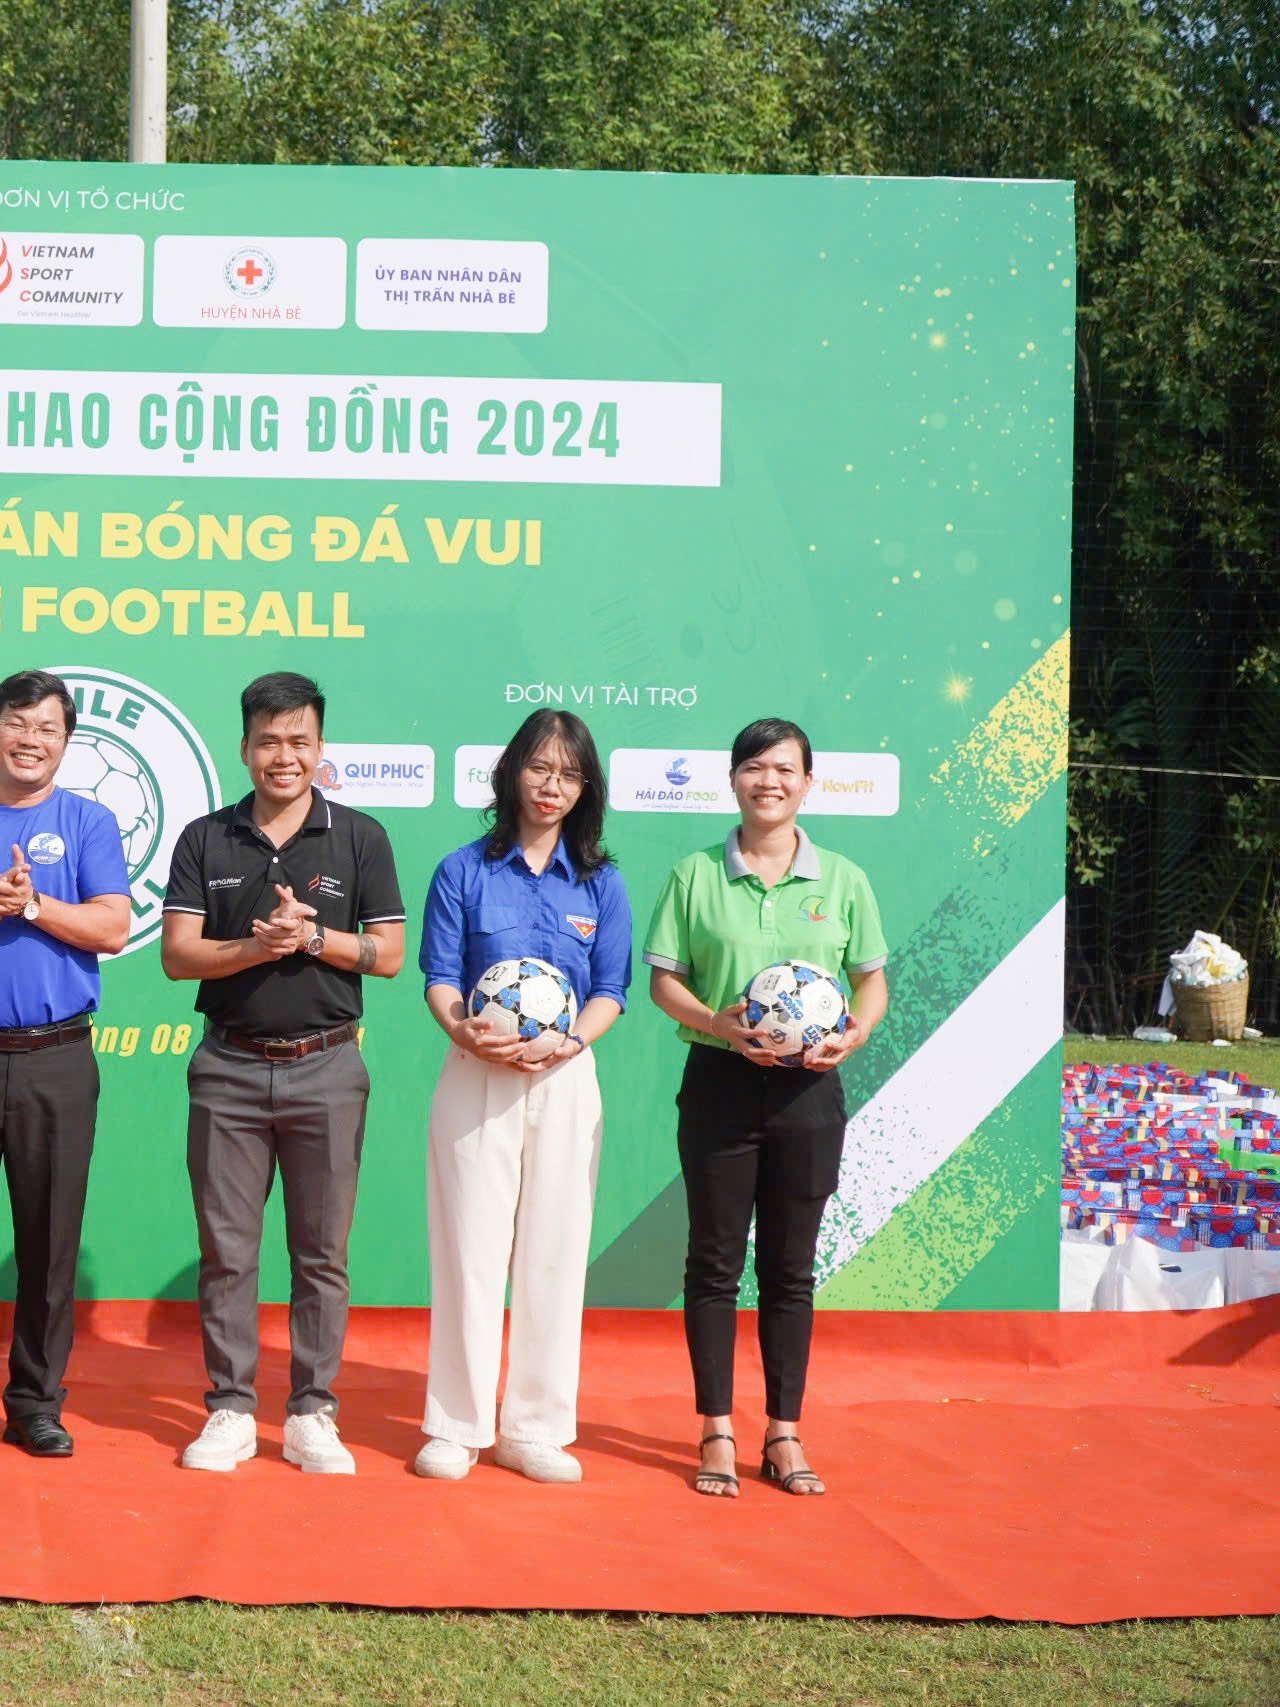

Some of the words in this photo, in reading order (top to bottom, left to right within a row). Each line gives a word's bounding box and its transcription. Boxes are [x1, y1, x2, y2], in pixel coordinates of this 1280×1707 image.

[47, 189, 70, 213] VỊ
[76, 185, 109, 210] TỔ
[115, 188, 185, 211] CHỨC
[21, 245, 95, 259] VIETNAM
[20, 267, 74, 281] SPORT
[375, 265, 395, 281] ỦY
[400, 269, 432, 281] BAN
[437, 267, 483, 282] NHÂN
[488, 268, 521, 283] DÂN
[19, 289, 124, 305] COMMUNITY
[384, 290, 409, 305] THỊ
[413, 286, 455, 302] TRẤN
[459, 289, 494, 304] NHÀ
[498, 289, 516, 304] BÈ
[201, 304, 247, 321] HUYỆN
[251, 305, 282, 320] NHÀ
[285, 305, 302, 320] BÈ
[138, 381, 280, 463] CỘNG
[306, 384, 449, 455] ĐỒNG
[476, 398, 620, 458] 2024
[100, 500, 293, 562] BÓNG
[310, 504, 410, 564] ĐÁ
[424, 517, 541, 566] VUI
[21, 586, 365, 639] FOOTBALL
[505, 682, 563, 704] ĐƠN
[571, 686, 594, 709] VỊ
[601, 683, 638, 705] TÀI
[646, 685, 697, 711] TRỢ
[73, 687, 146, 730] ILE
[344, 763, 376, 778] QUI
[381, 764, 424, 779] PHUC
[822, 779, 874, 793] NowFit
[685, 792, 718, 801] FOOD
[150, 1023, 192, 1055] 08
